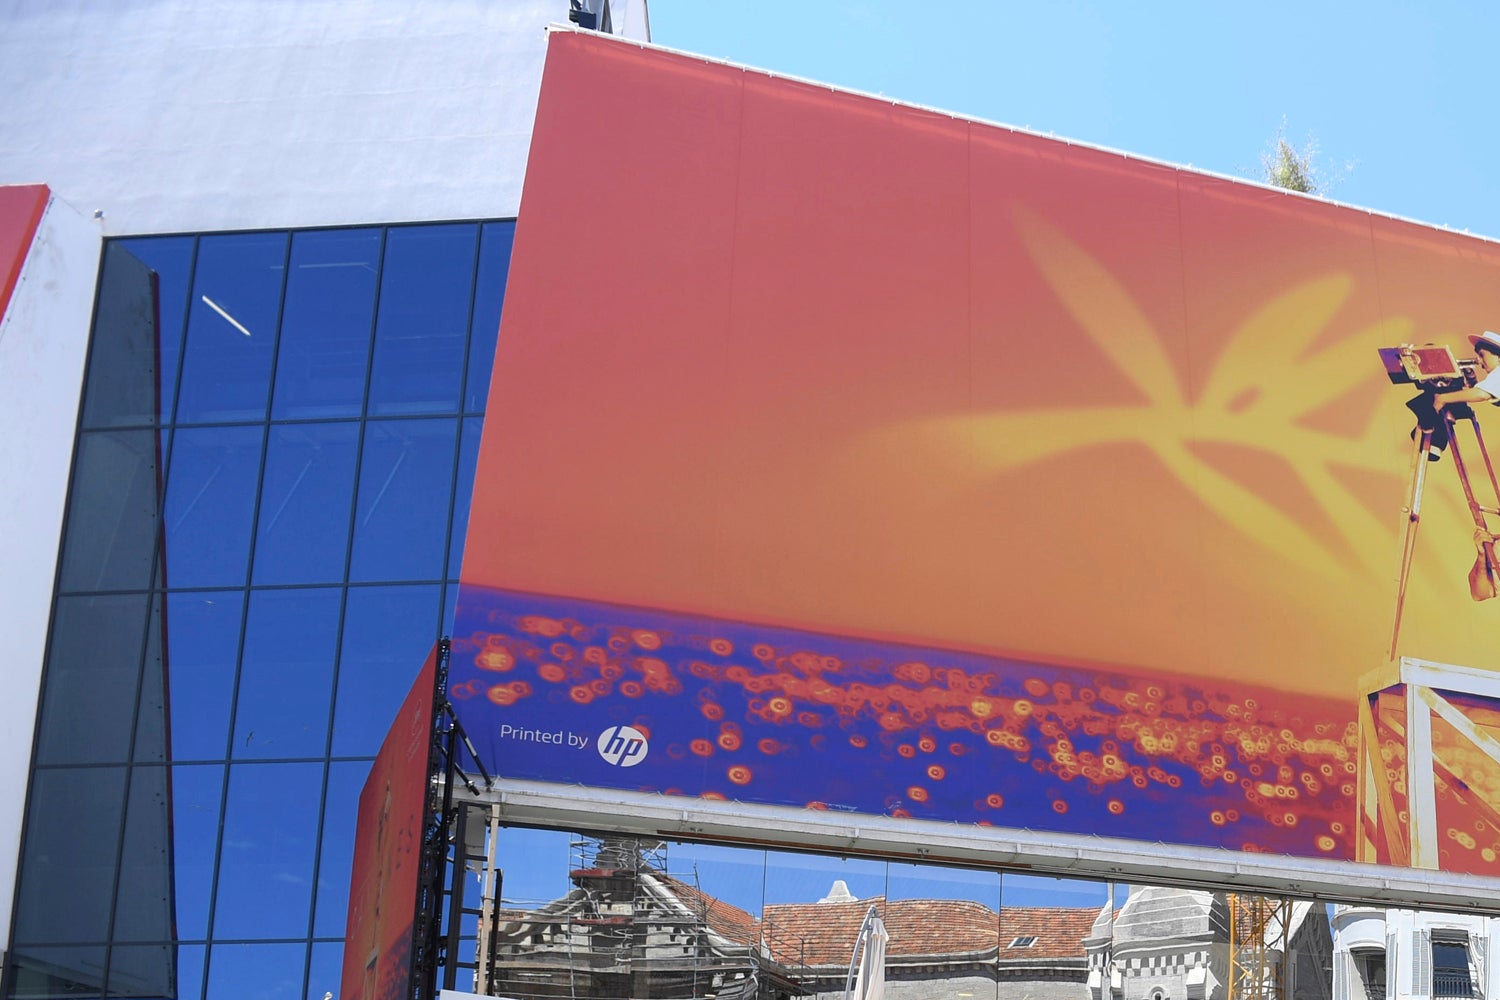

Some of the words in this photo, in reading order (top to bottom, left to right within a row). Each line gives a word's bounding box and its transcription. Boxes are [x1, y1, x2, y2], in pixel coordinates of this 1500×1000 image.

[500, 724, 563, 745] Printed
[567, 731, 589, 750] by
[602, 726, 645, 766] hp
